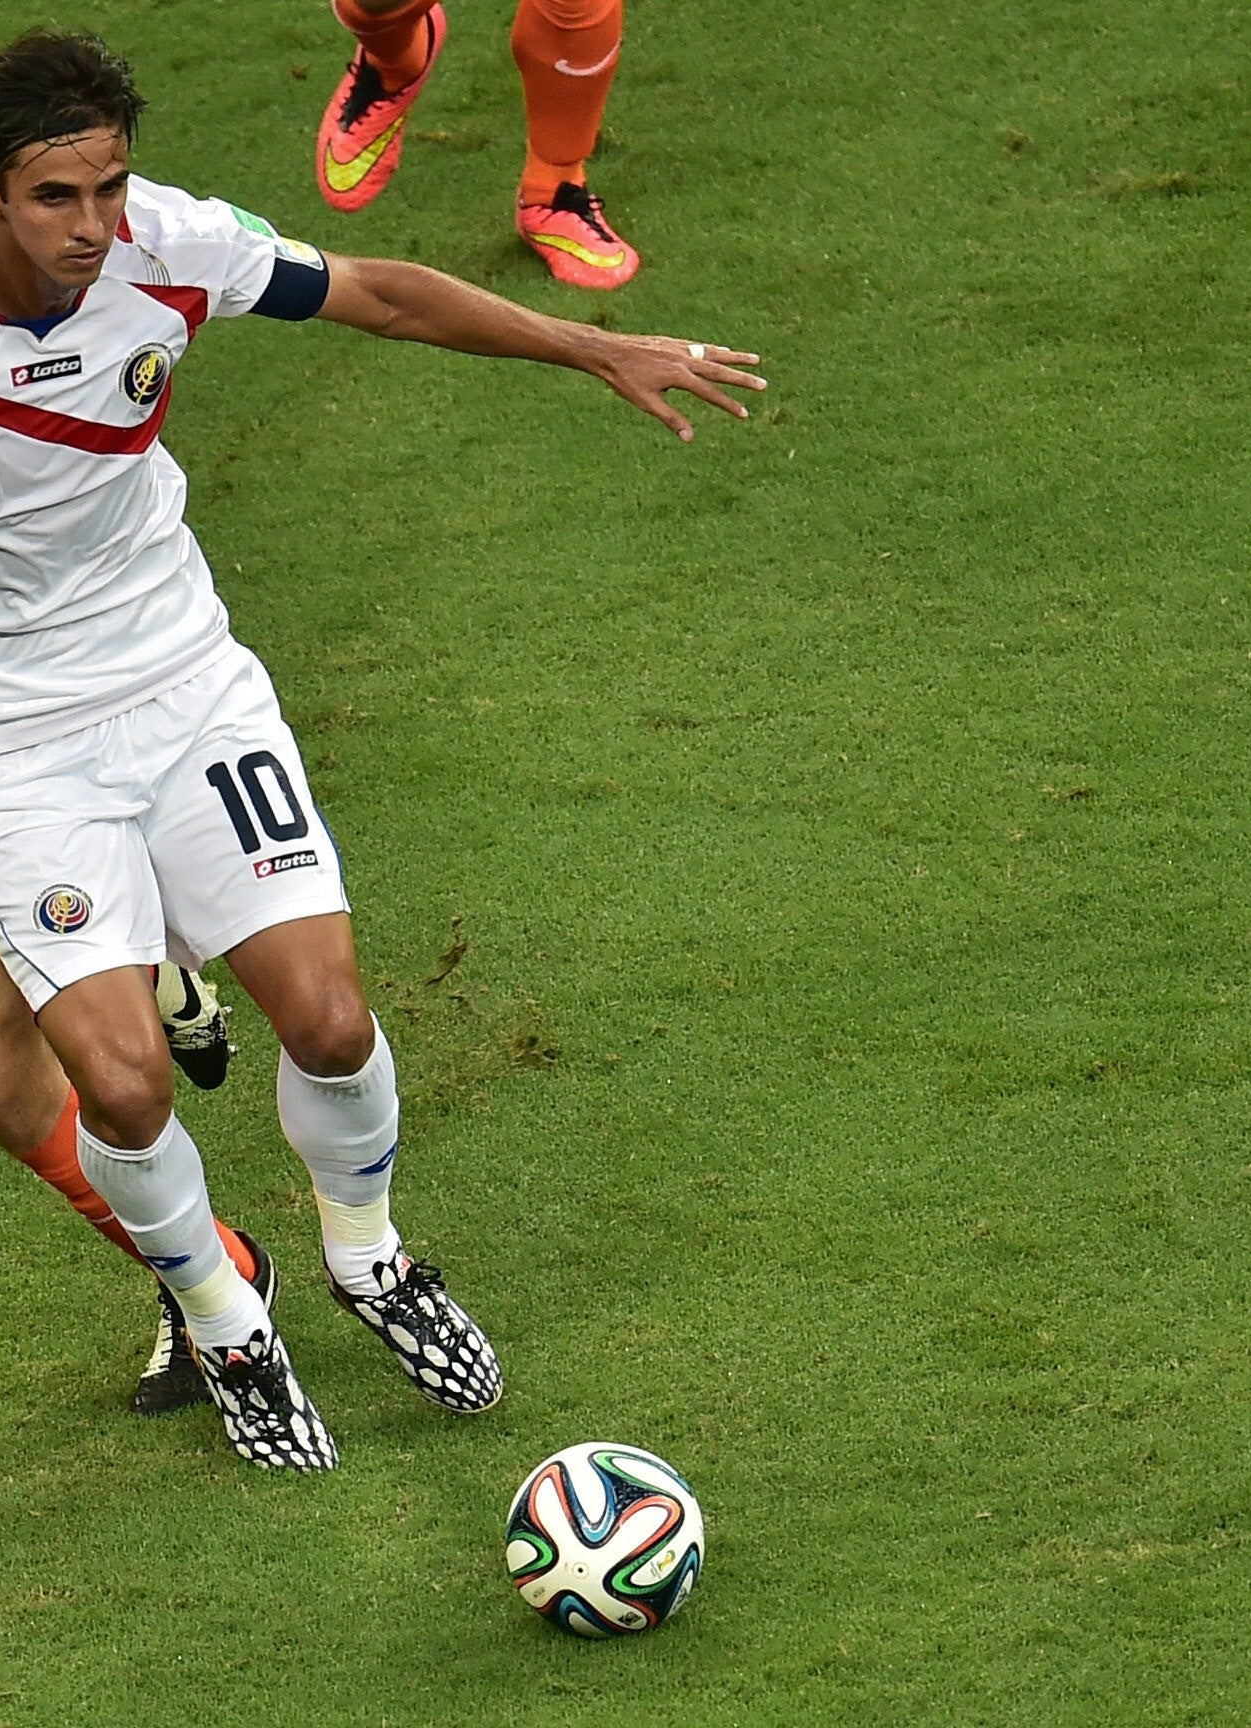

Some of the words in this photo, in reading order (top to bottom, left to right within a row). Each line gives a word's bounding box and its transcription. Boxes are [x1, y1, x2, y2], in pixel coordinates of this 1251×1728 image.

[32, 360, 80, 378] lotto
[205, 751, 308, 855] 10
[274, 853, 316, 871] lotto
